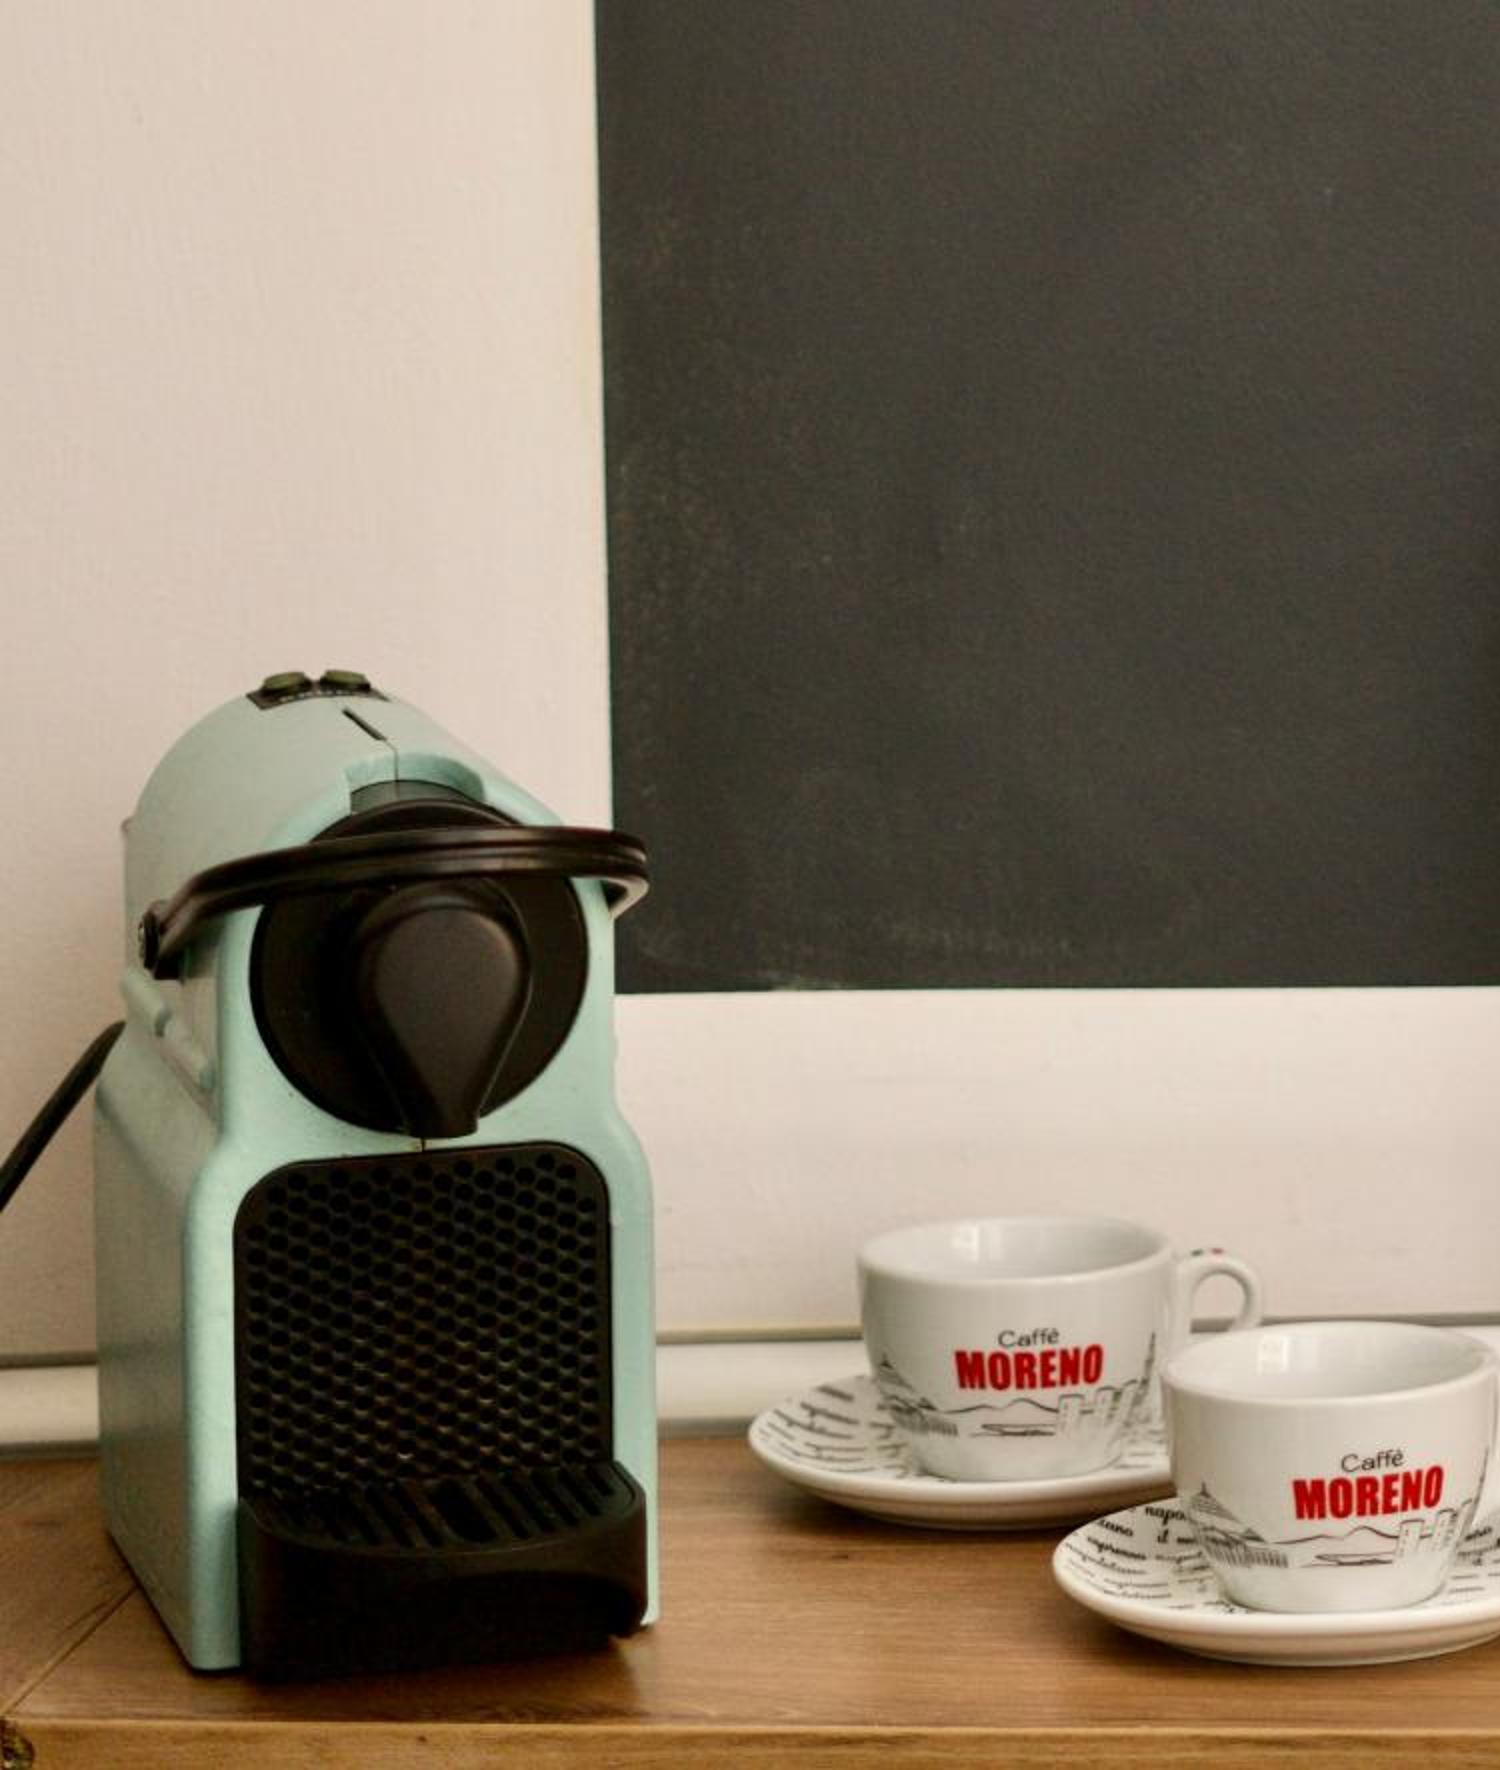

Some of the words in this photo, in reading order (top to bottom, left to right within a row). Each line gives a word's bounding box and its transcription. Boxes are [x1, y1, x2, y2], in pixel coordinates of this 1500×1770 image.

[998, 1328, 1060, 1347] Caffè
[955, 1344, 1104, 1391] MORENO
[1341, 1448, 1404, 1472] Caffè
[1293, 1465, 1444, 1520] MORENO
